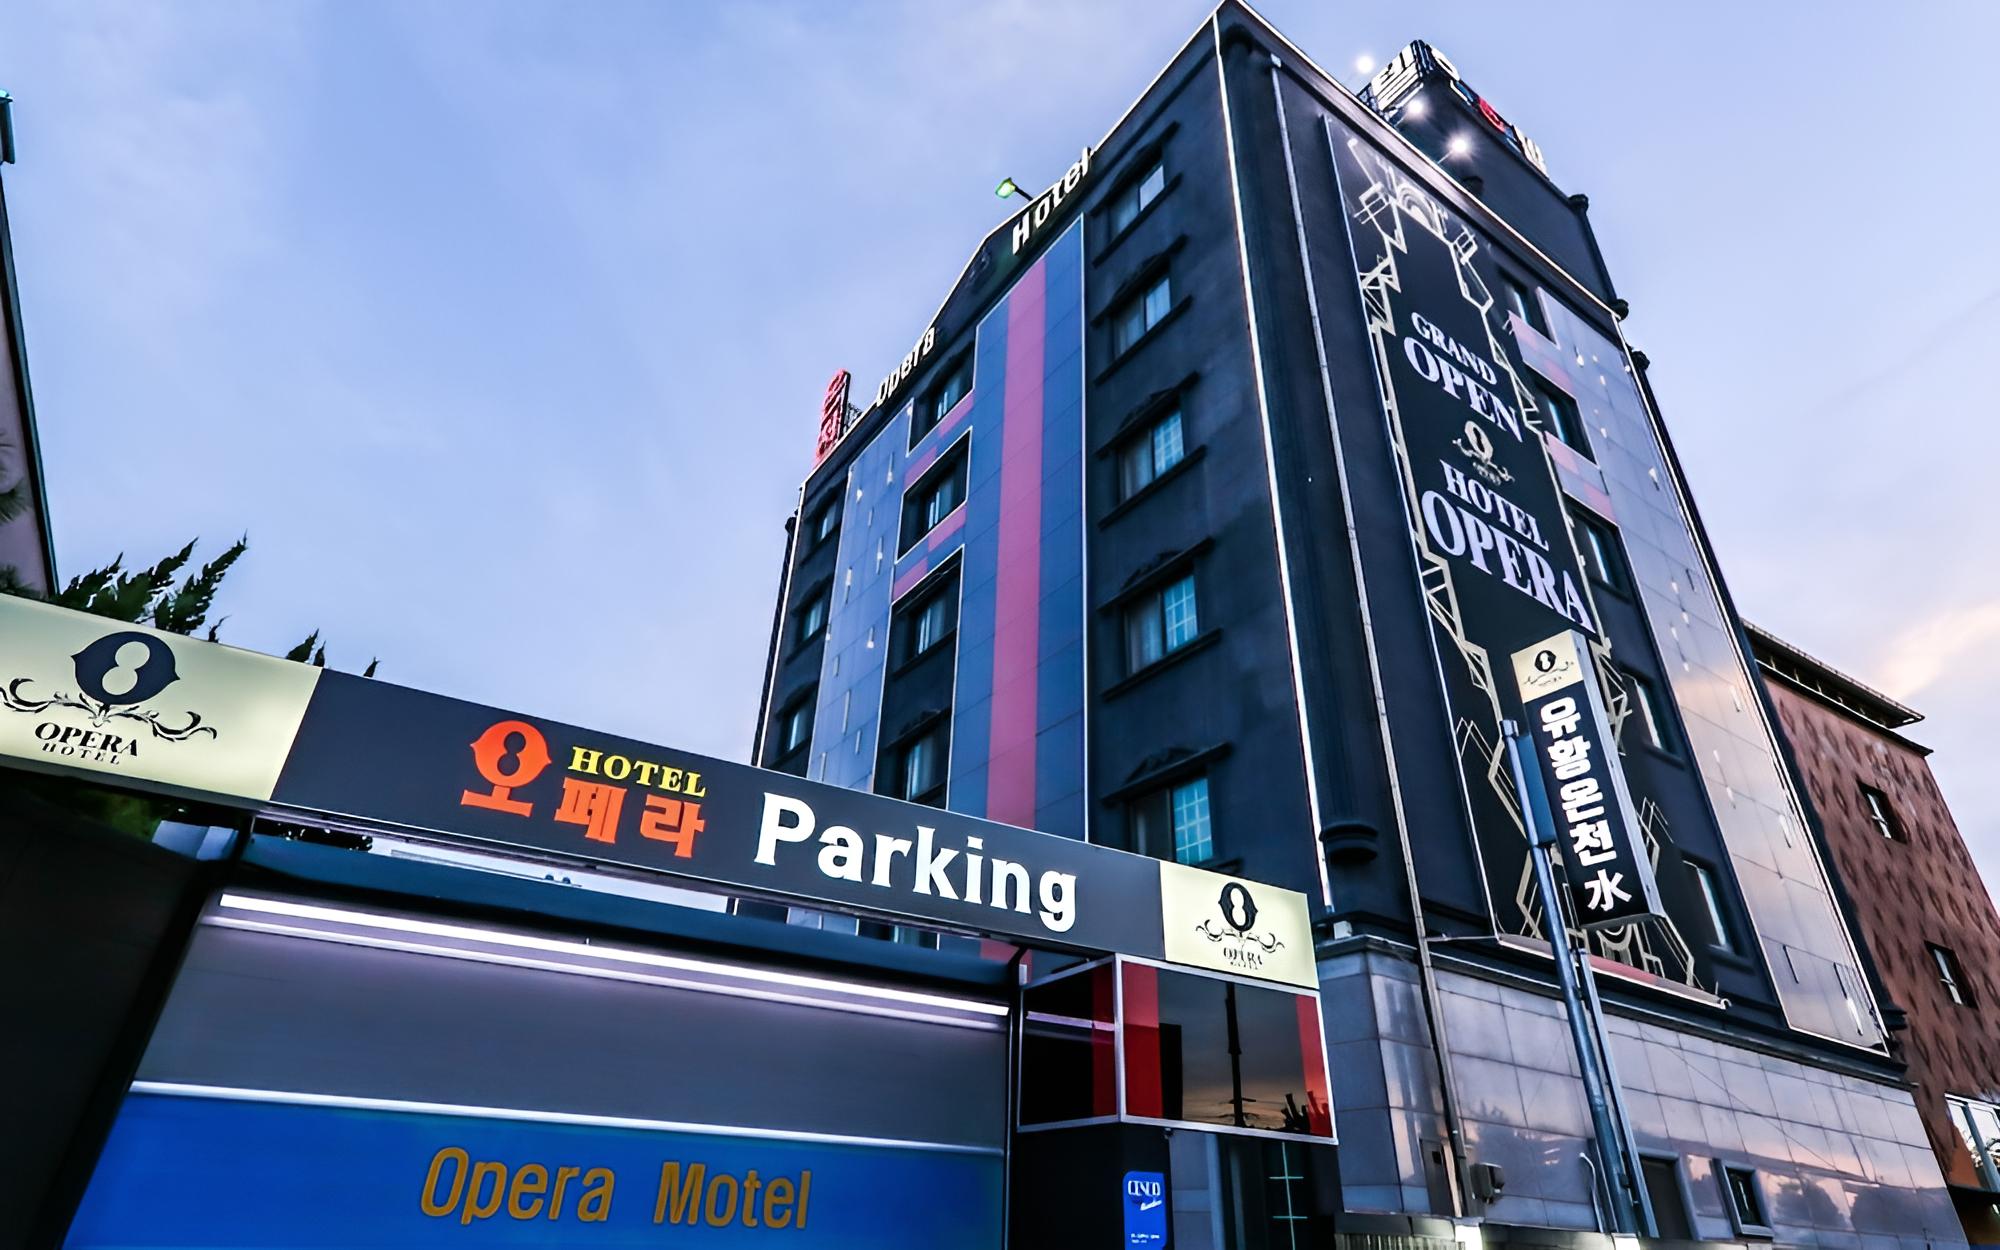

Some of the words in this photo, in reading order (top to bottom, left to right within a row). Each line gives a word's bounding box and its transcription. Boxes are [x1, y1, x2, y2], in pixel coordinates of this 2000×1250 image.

[1012, 146, 1092, 254] Hotel
[1403, 336, 1523, 442] OPEN
[1411, 311, 1498, 385] GRAND
[1439, 458, 1550, 551] HOTEL
[1421, 490, 1597, 634] OPERA
[35, 722, 138, 757] OPERA
[42, 742, 120, 765] HOTEL
[567, 745, 706, 798] HOTEL
[461, 719, 706, 858] 오페라
[753, 792, 1079, 934] Parking
[420, 1146, 616, 1226] Opera
[653, 1160, 813, 1229] Motel
